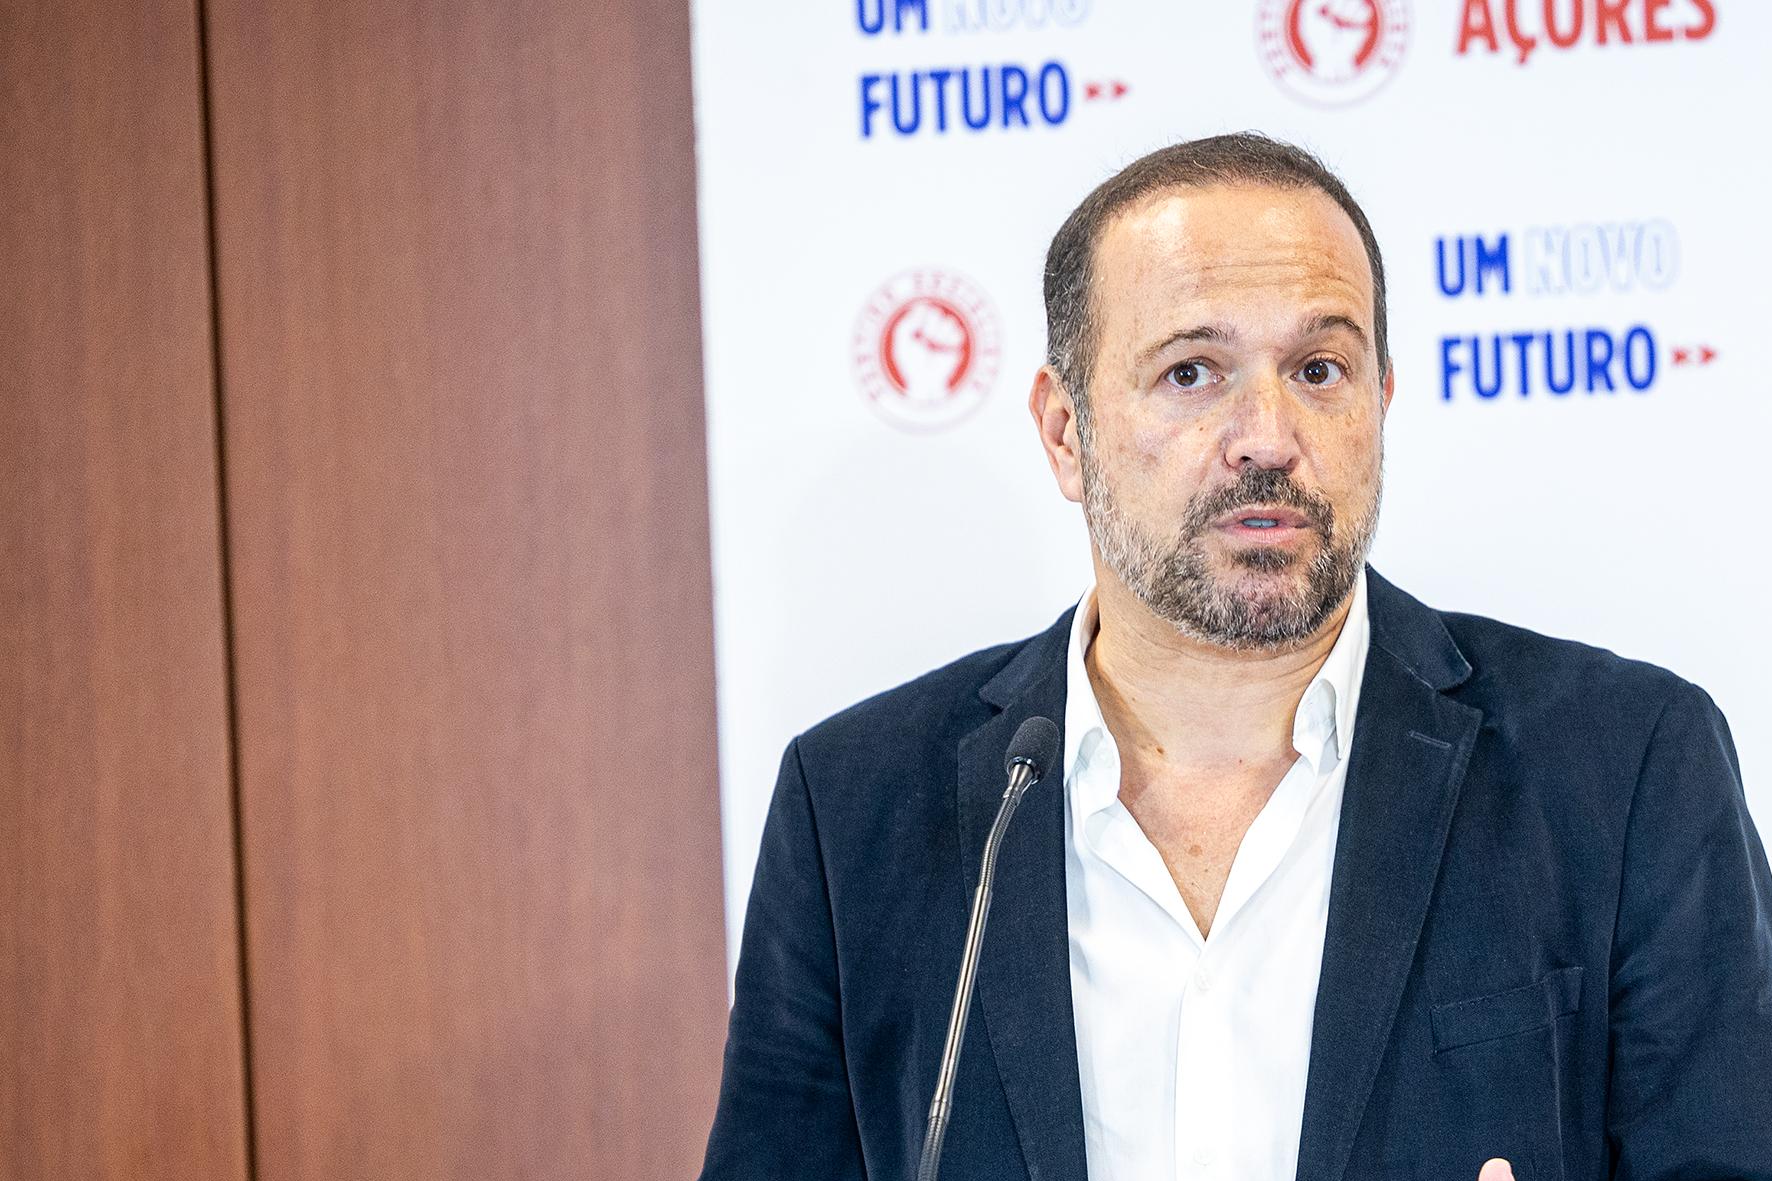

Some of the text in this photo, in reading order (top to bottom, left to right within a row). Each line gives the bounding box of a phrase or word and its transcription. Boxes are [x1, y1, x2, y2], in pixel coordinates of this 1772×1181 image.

[859, 61, 1069, 138] FUTURO
[1436, 233, 1511, 297] UM
[1440, 323, 1657, 401] FUTURO
